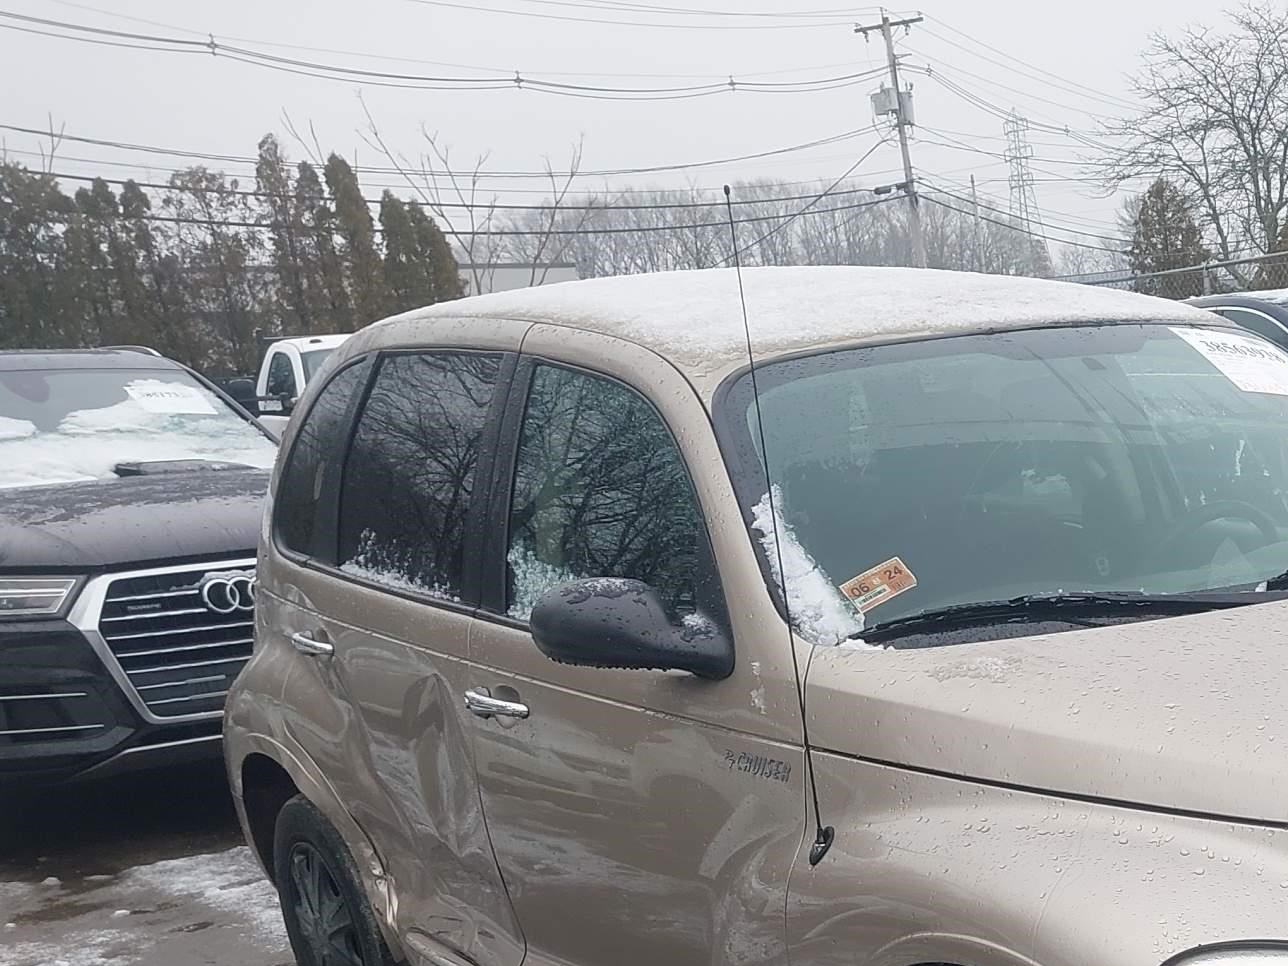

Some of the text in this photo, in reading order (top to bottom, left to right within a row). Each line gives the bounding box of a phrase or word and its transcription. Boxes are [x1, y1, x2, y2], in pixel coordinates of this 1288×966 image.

[850, 582, 870, 597] 06
[883, 565, 903, 581] 24
[737, 751, 792, 783] CRUISER
